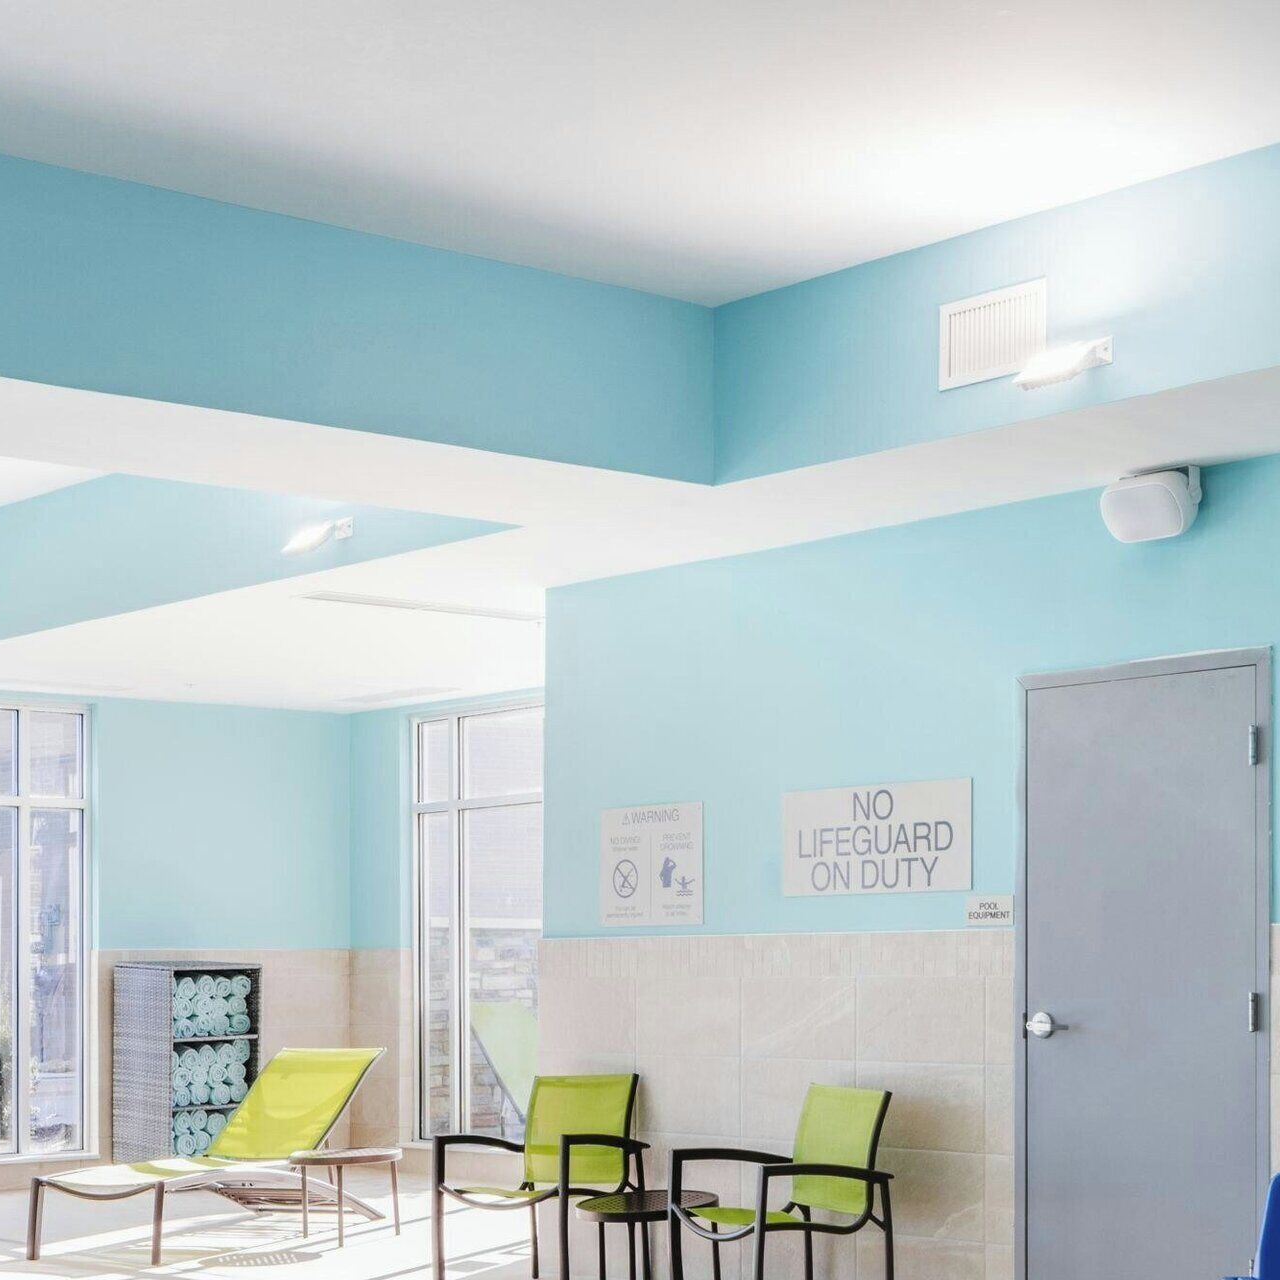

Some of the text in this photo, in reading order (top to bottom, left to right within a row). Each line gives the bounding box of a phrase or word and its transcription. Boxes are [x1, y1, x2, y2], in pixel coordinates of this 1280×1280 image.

[631, 808, 680, 824] WARNING
[853, 789, 894, 821] NO
[798, 820, 954, 859] LIFEGUARD
[811, 856, 939, 891] ON DUTY
[968, 911, 1010, 920] EQUIPMENT
[979, 902, 999, 911] POOL
